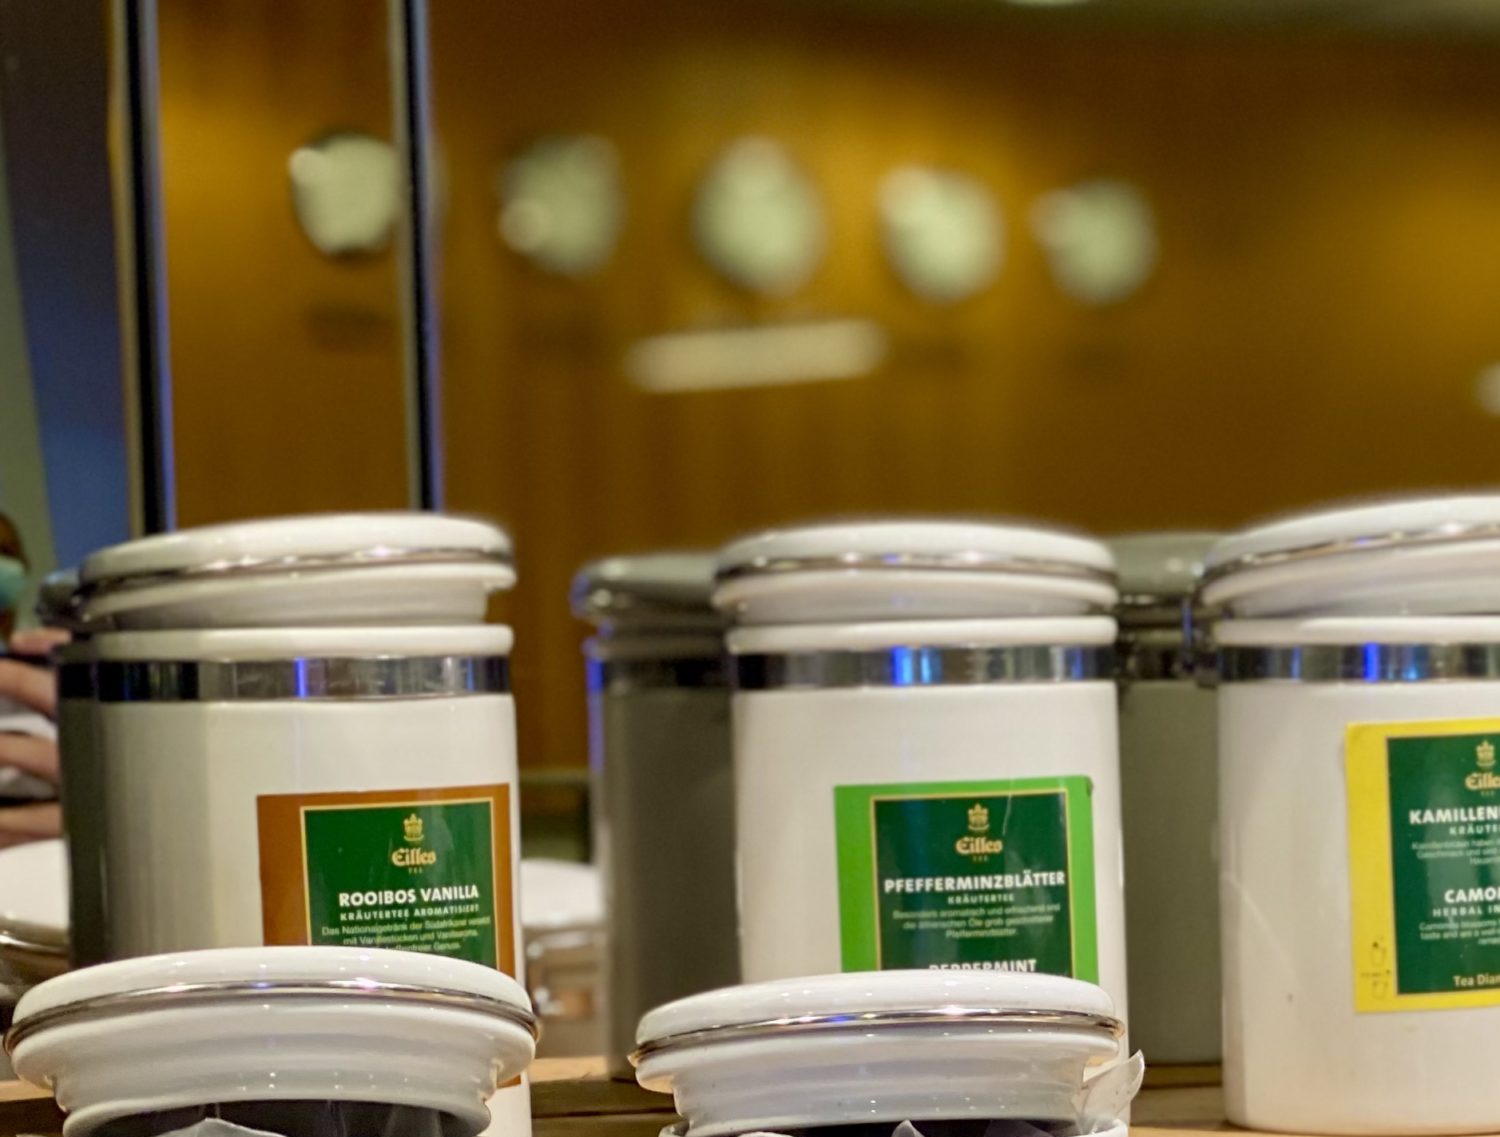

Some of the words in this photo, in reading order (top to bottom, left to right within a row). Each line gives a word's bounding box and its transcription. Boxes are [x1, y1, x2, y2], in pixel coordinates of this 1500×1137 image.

[884, 869, 1066, 893] PFEFFERMINZBLÄTTER
[338, 889, 416, 907] ROOIBOS
[420, 885, 479, 903] VANILLA
[947, 893, 1015, 905] KRÄUTERTEE
[340, 908, 409, 921] KRÄUTERTEE
[1432, 906, 1483, 918] HERBAL
[1453, 975, 1475, 987] Tea
